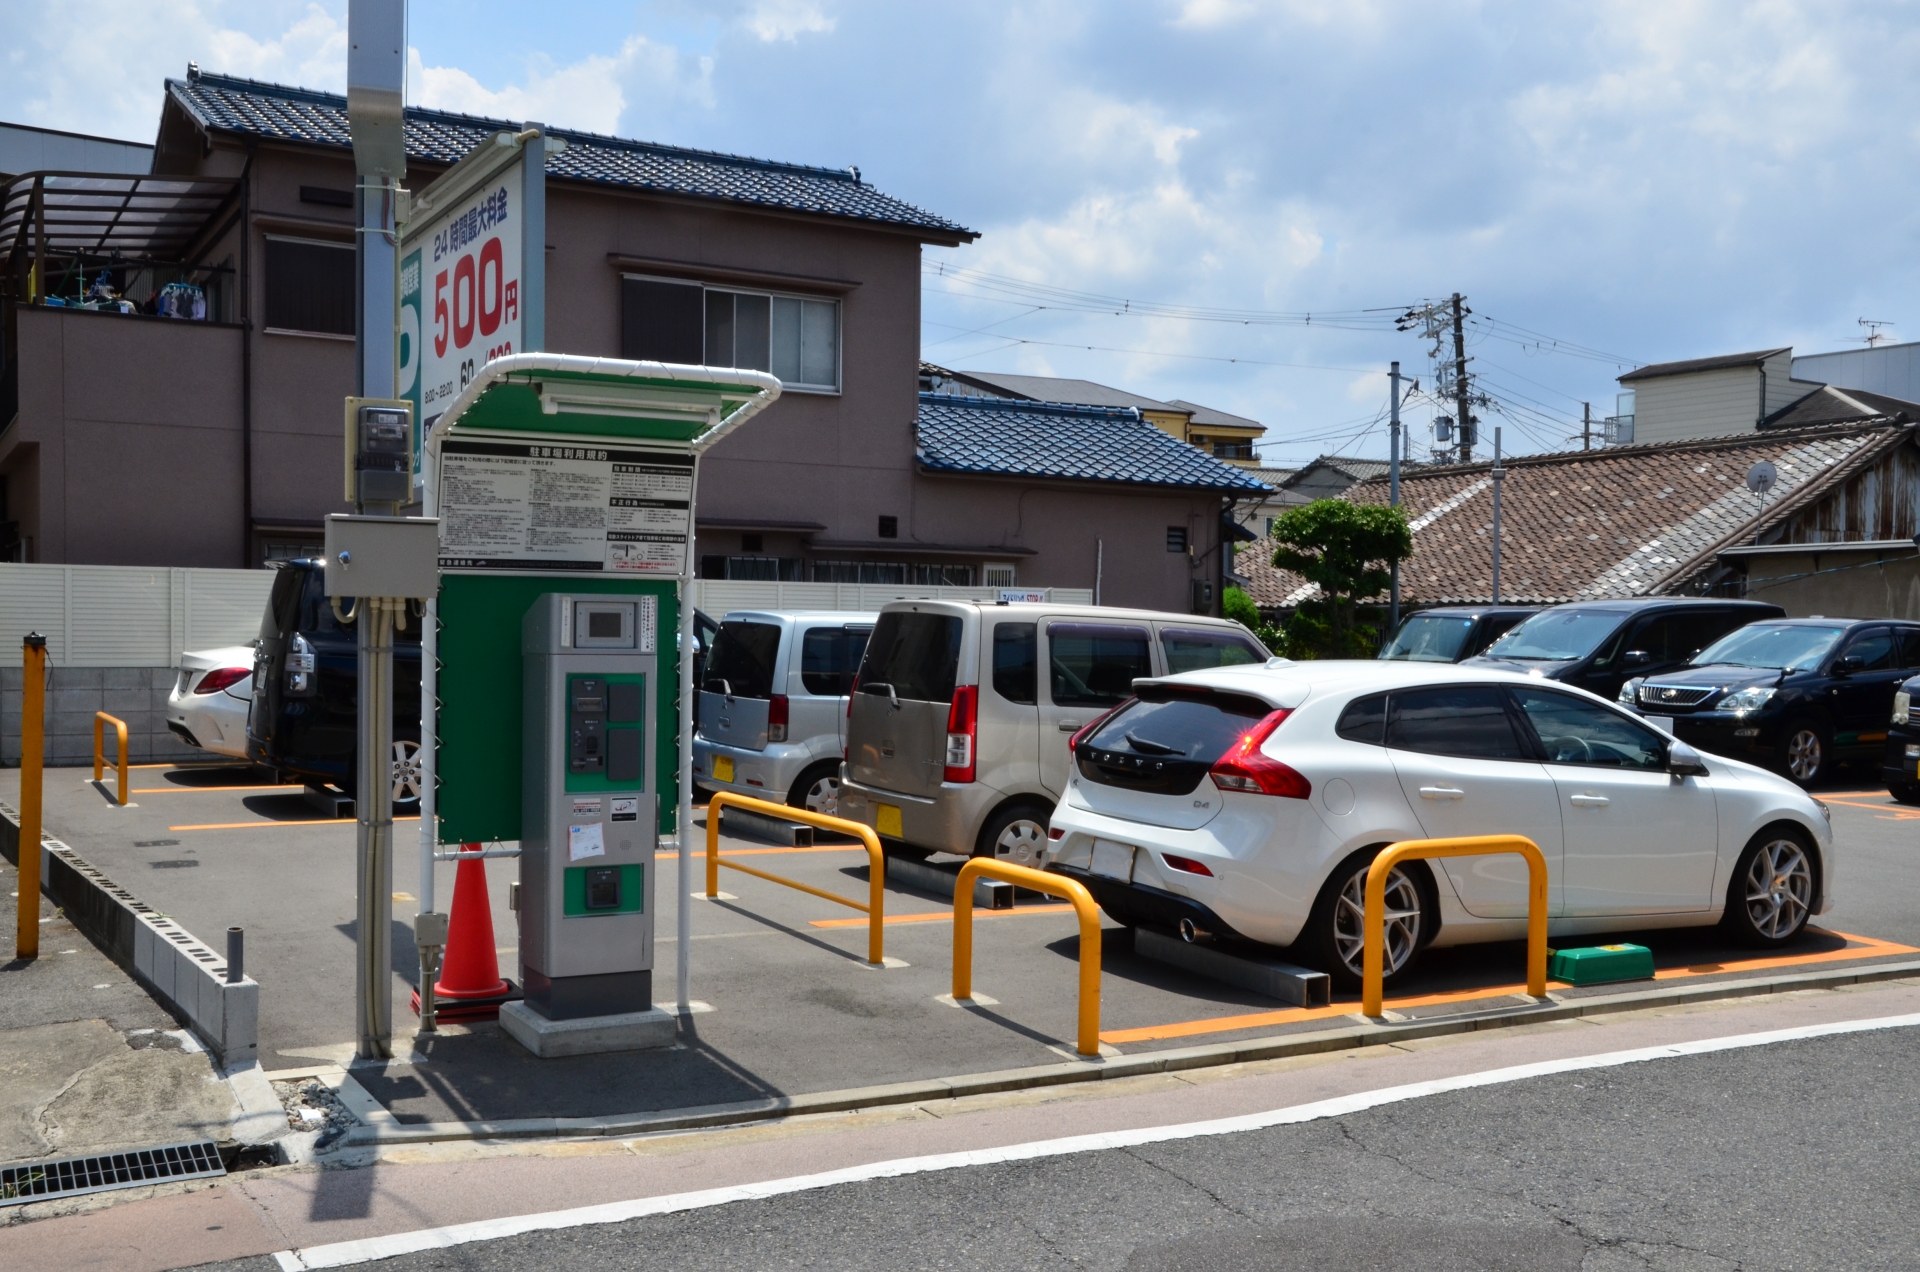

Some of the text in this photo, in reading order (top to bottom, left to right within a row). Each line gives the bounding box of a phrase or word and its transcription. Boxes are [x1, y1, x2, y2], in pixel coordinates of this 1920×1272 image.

[529, 446, 608, 461] 駐車場利用規約
[1090, 752, 1163, 770] VOLVO
